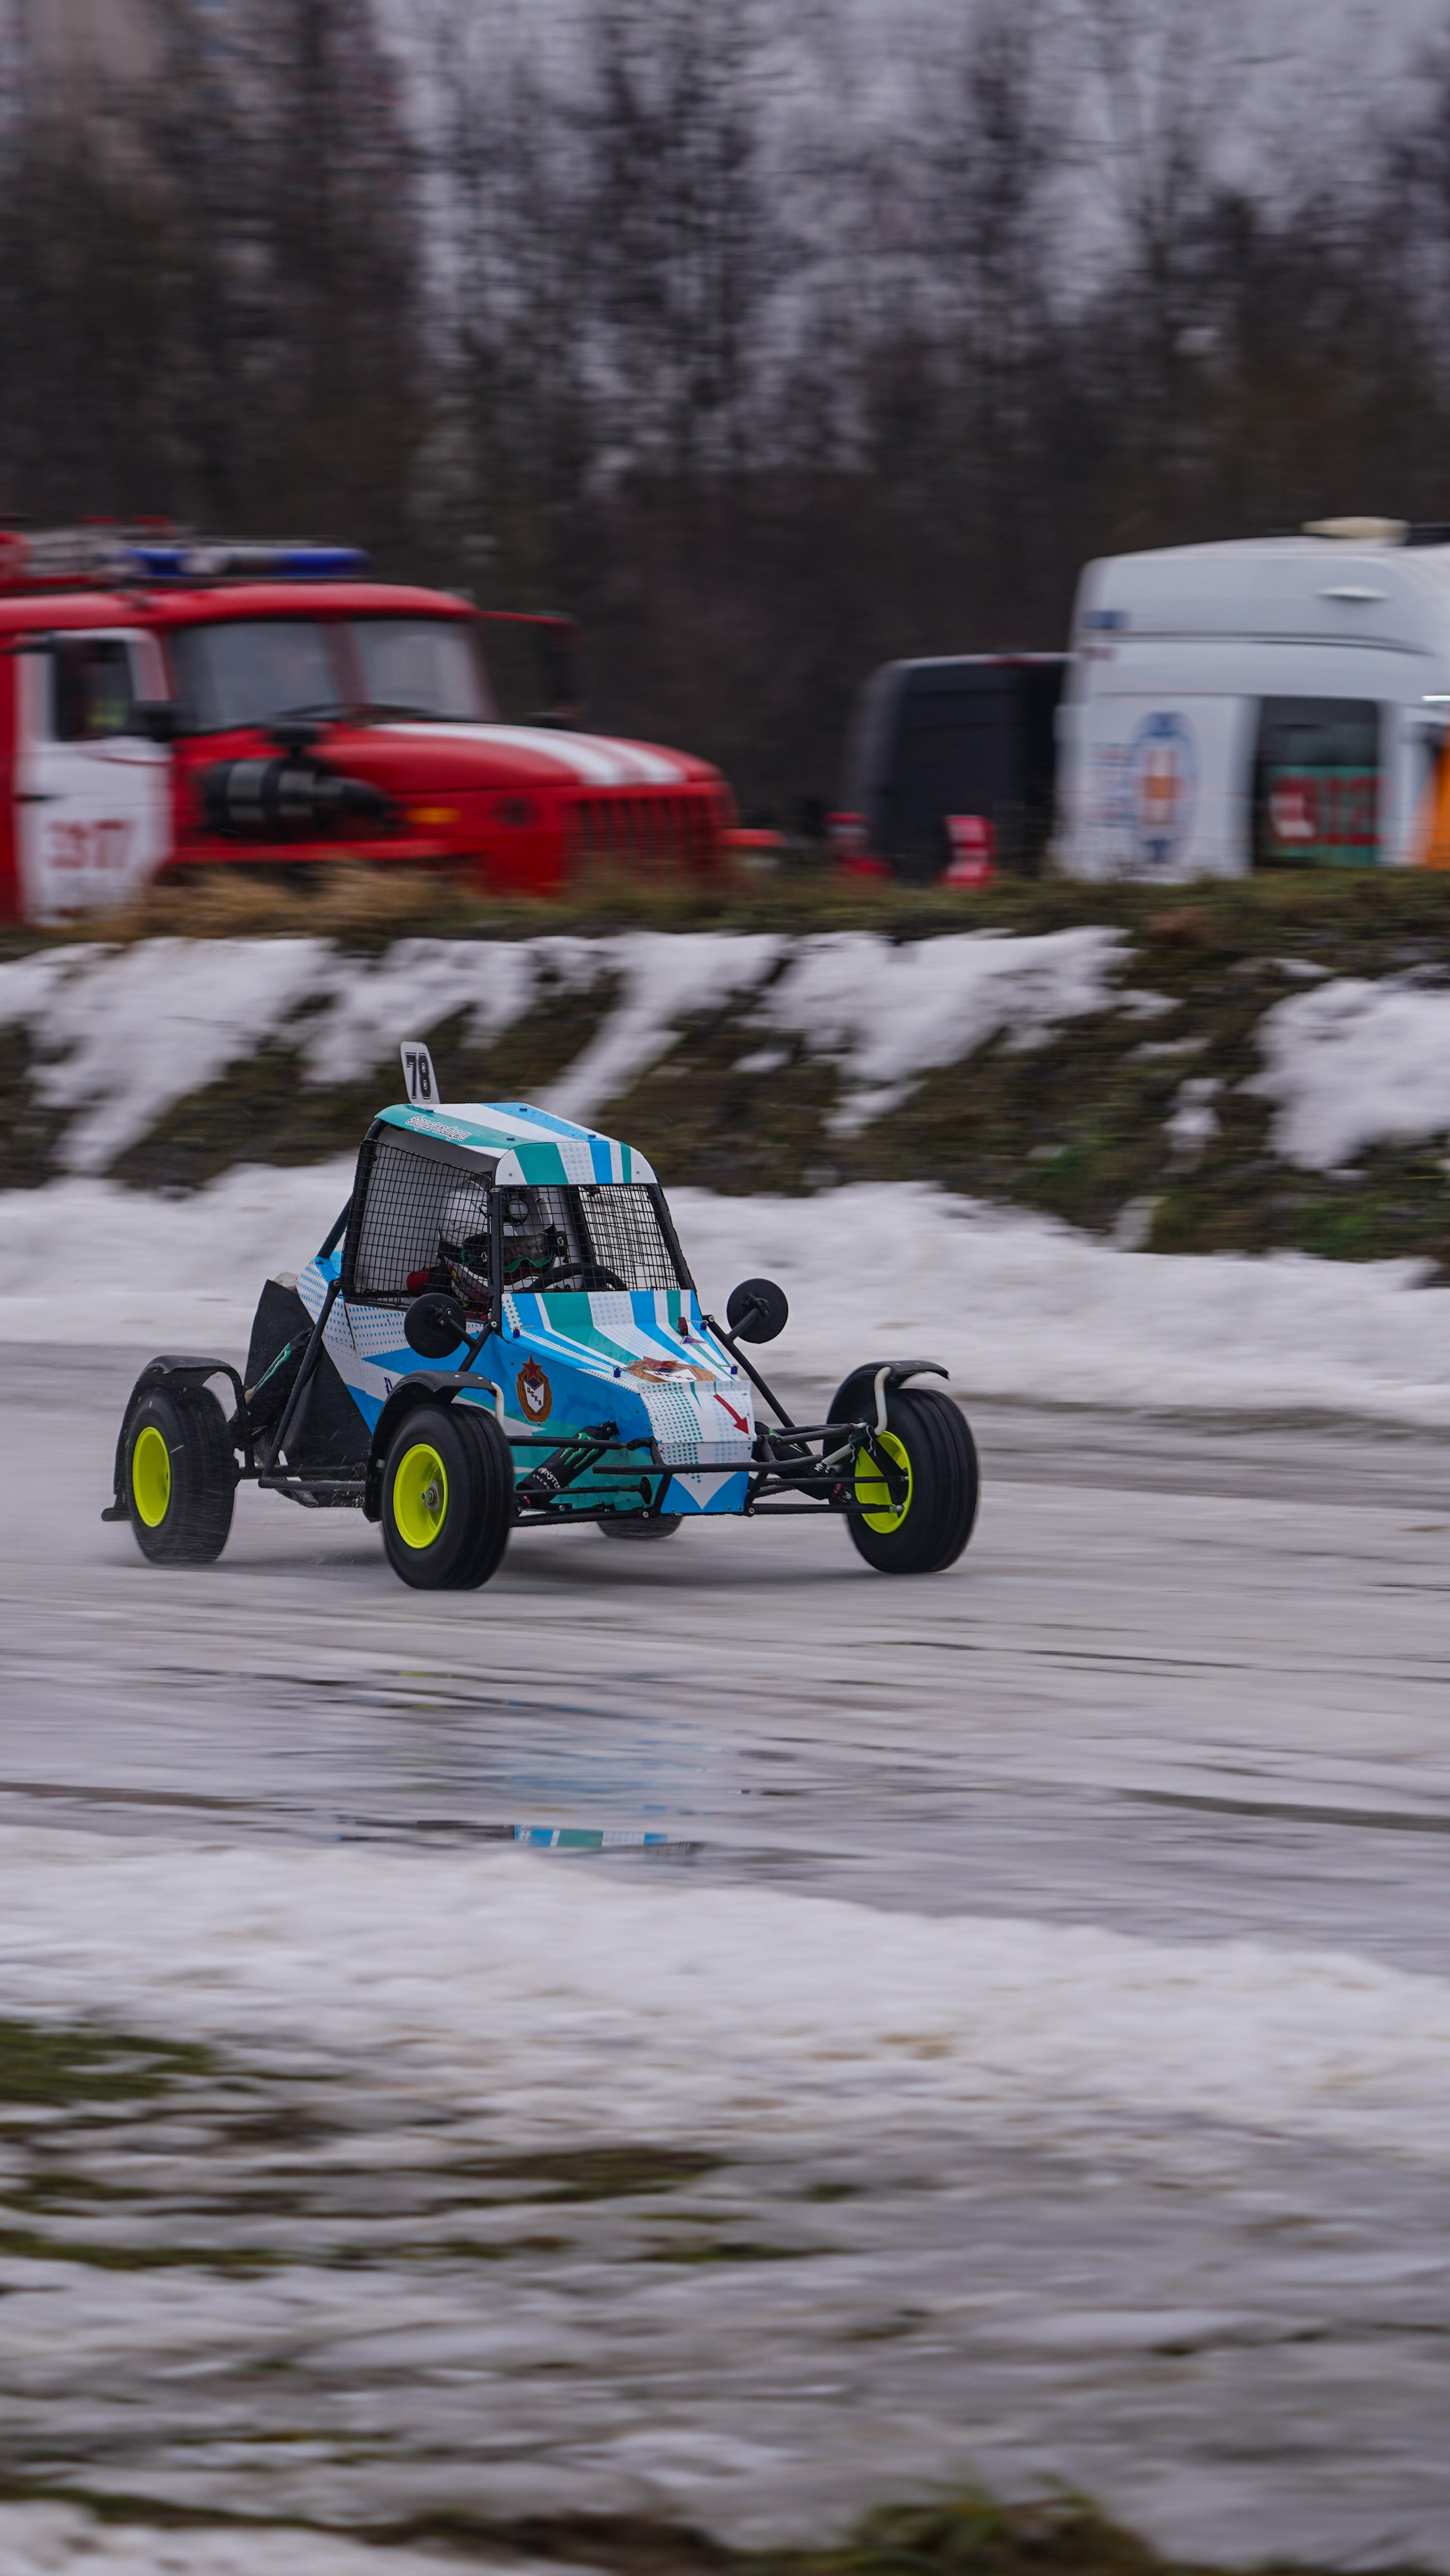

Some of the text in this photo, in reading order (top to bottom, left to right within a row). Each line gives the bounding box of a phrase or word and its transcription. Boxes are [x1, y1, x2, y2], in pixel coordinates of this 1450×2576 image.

[405, 1052, 432, 1099] 78
[527, 1387, 542, 1406] ЦСКА
[537, 1467, 561, 1489] MONSTER
